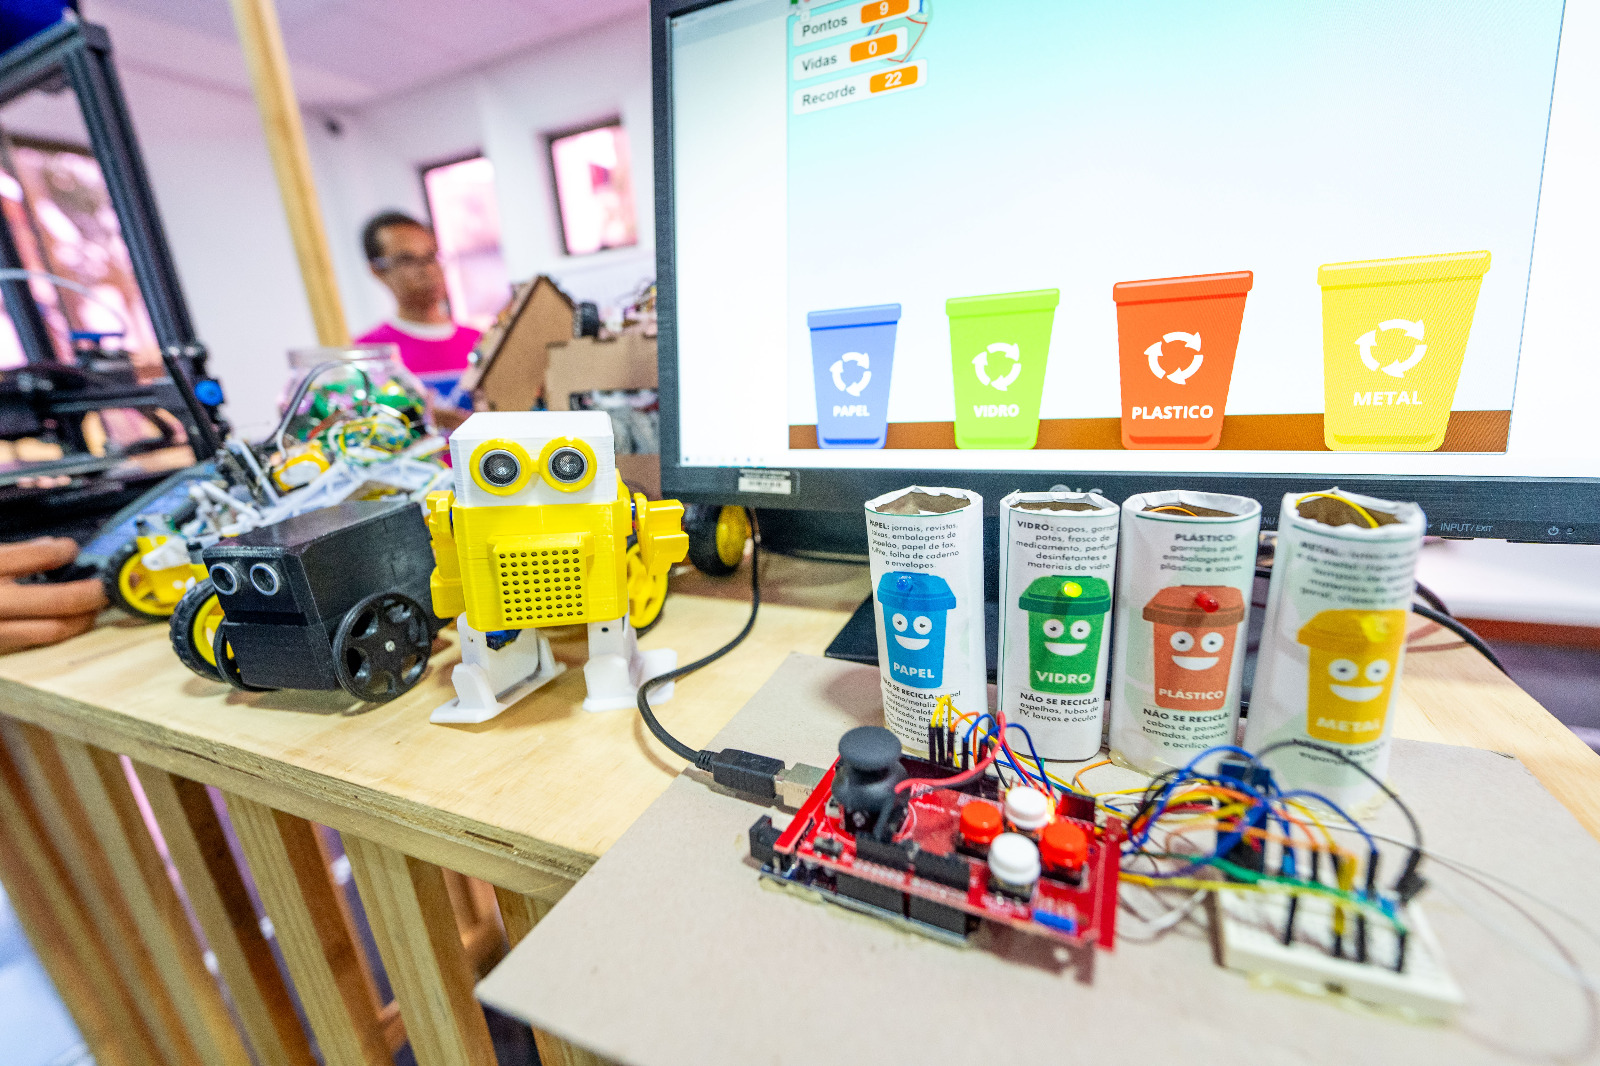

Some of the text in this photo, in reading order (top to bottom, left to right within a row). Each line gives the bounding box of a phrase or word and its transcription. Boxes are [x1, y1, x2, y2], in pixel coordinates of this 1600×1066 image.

[802, 3, 889, 37] Pontos 9
[802, 41, 878, 72] Vidas 0
[802, 71, 903, 107] Recorde 22
[1353, 391, 1423, 407] METAL
[833, 405, 870, 417] PAPEL
[973, 404, 1020, 418] VIDRO
[1132, 405, 1214, 420] PLASTICO
[891, 524, 923, 533] jornais,
[1017, 520, 1054, 531] VIDRO:
[892, 532, 945, 542] embalagens
[902, 543, 926, 551] papel
[1016, 540, 1082, 552] medicamento,
[890, 550, 910, 559] folha
[926, 550, 960, 559] caderno
[1036, 552, 1100, 561] desinfetantes
[1027, 561, 1072, 571] materiais
[893, 662, 935, 679] PAPEL
[1036, 670, 1091, 684] VIDRO
[1060, 697, 1100, 706] RECICLA:
[1020, 702, 1062, 714] espelhos,
[1064, 707, 1088, 715] tubos
[1019, 709, 1030, 718] TV,
[1032, 713, 1061, 722] louças
[1172, 714, 1185, 722] SE
[1146, 720, 1176, 730] cabos
[1142, 726, 1189, 740] tomadas,
